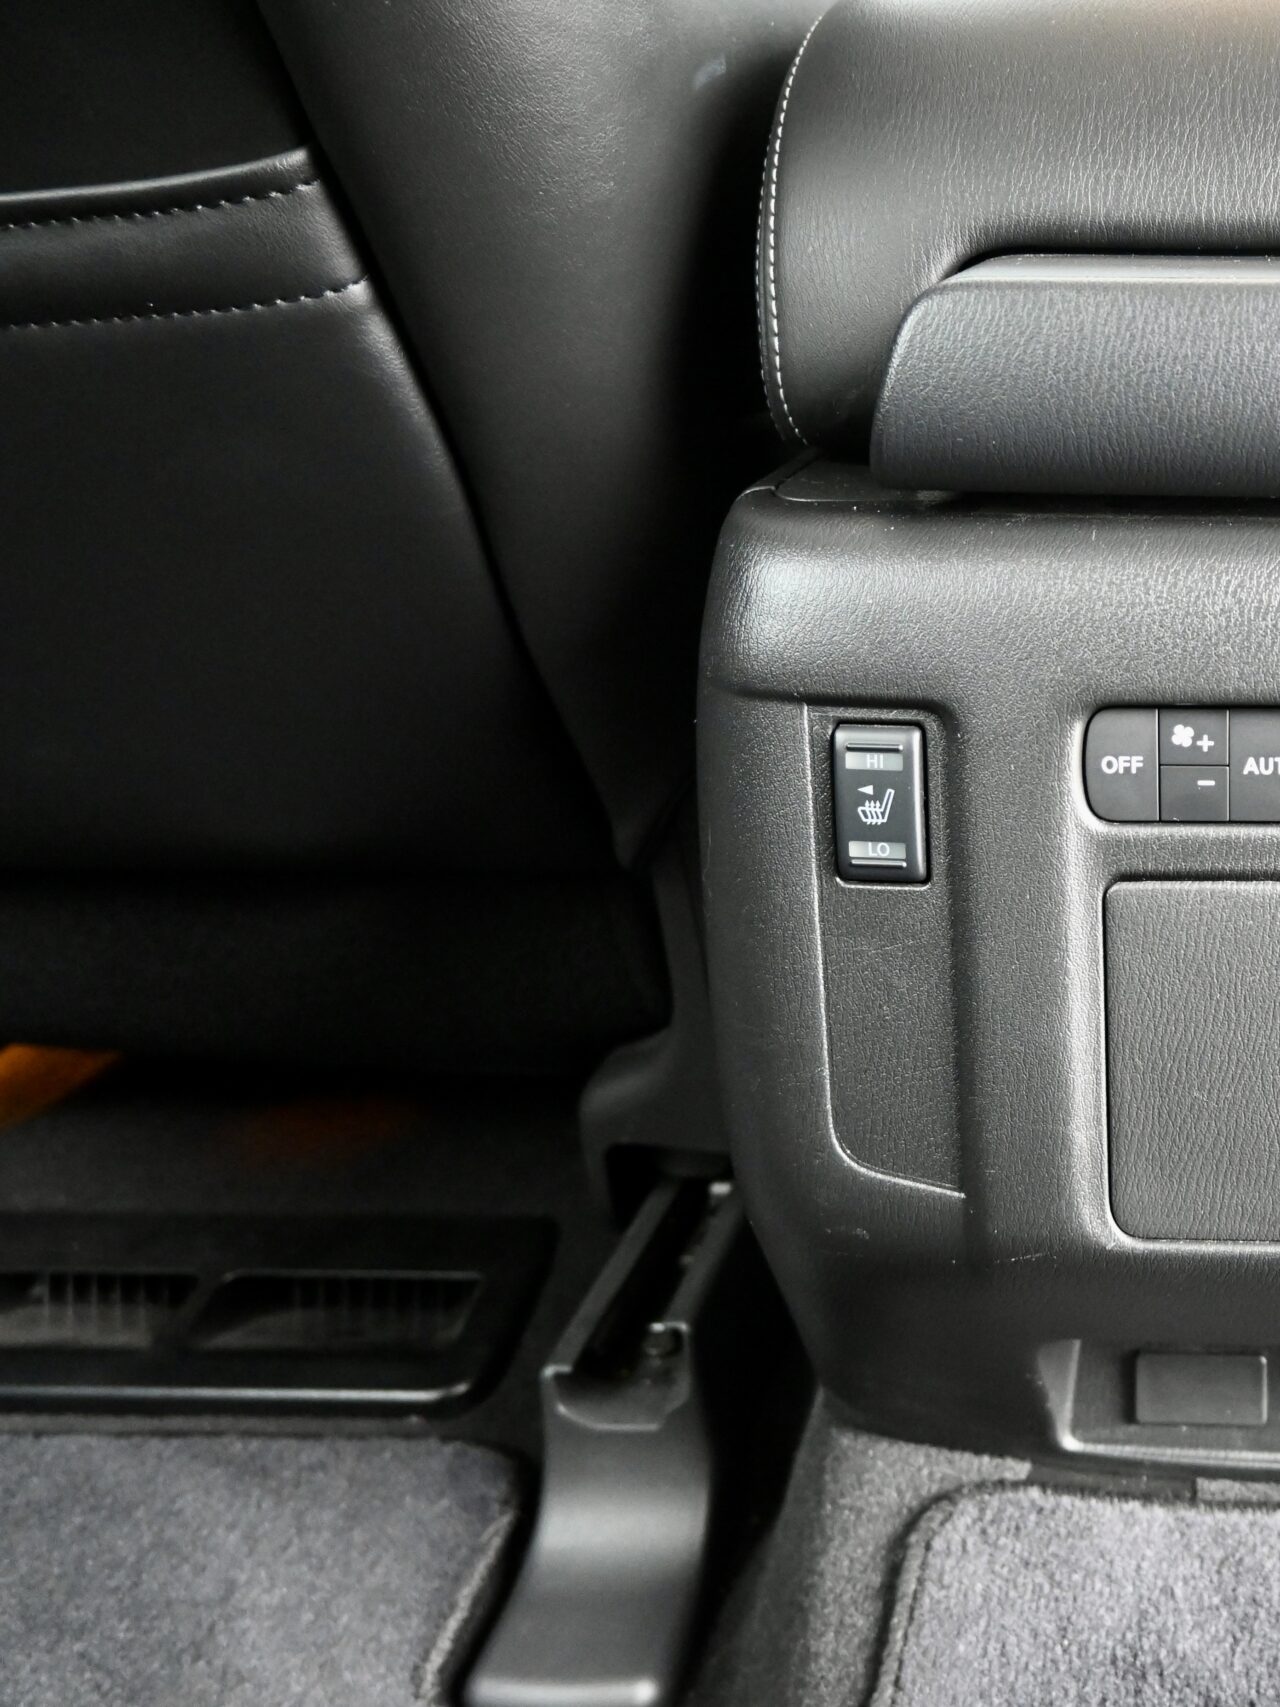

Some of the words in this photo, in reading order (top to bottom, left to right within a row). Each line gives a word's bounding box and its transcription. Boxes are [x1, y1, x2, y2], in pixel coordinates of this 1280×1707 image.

[866, 754, 884, 769] HI
[1101, 755, 1144, 774] OFF
[868, 842, 890, 857] LO
